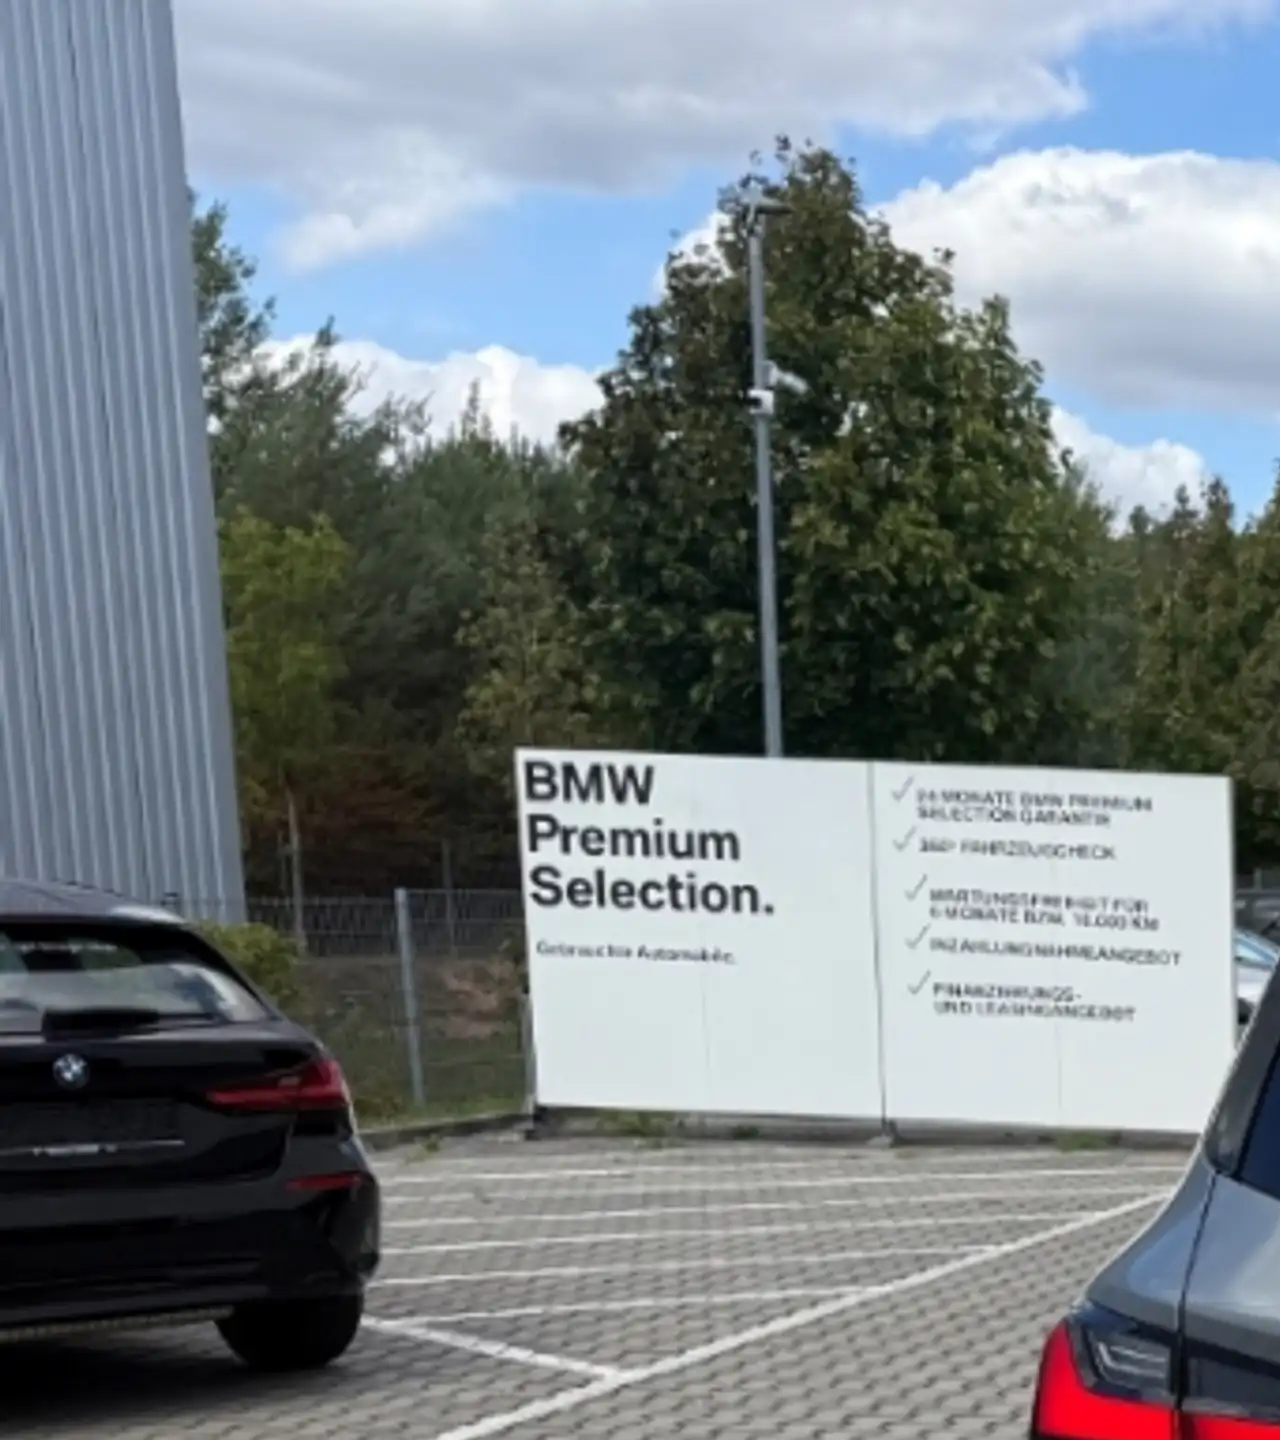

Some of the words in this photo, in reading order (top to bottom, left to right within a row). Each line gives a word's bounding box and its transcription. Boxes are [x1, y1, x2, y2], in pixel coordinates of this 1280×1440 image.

[524, 760, 654, 805] BMW
[941, 790, 1015, 806] MONATE
[918, 806, 1016, 823] SELECTION
[527, 813, 740, 861] Premium
[529, 865, 775, 915] Selection.
[946, 907, 1018, 924] MONATE
[934, 1001, 971, 1015] UND
